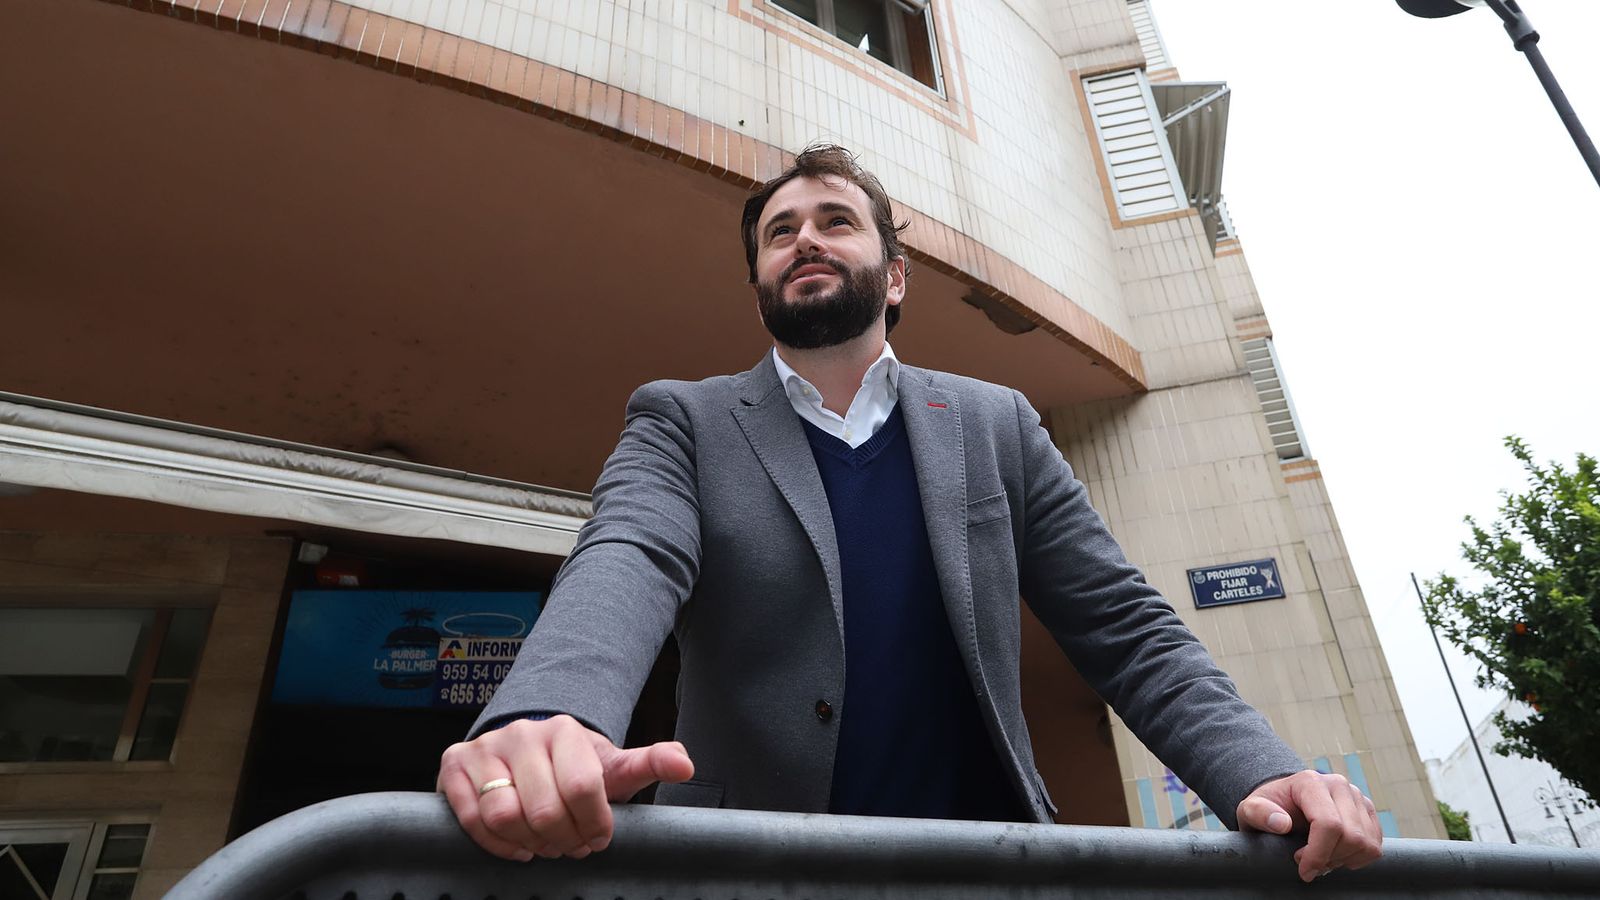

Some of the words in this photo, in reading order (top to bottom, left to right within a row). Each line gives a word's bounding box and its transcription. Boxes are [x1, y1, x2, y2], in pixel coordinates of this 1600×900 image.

[1206, 565, 1257, 581] PROHIBIDO
[1221, 577, 1248, 589] FIJAR
[1213, 585, 1264, 601] CARTELES
[374, 658, 389, 671] LA
[442, 664, 468, 681] 959
[472, 664, 489, 680] 54
[450, 683, 475, 704] 656
[476, 683, 500, 704] 36
